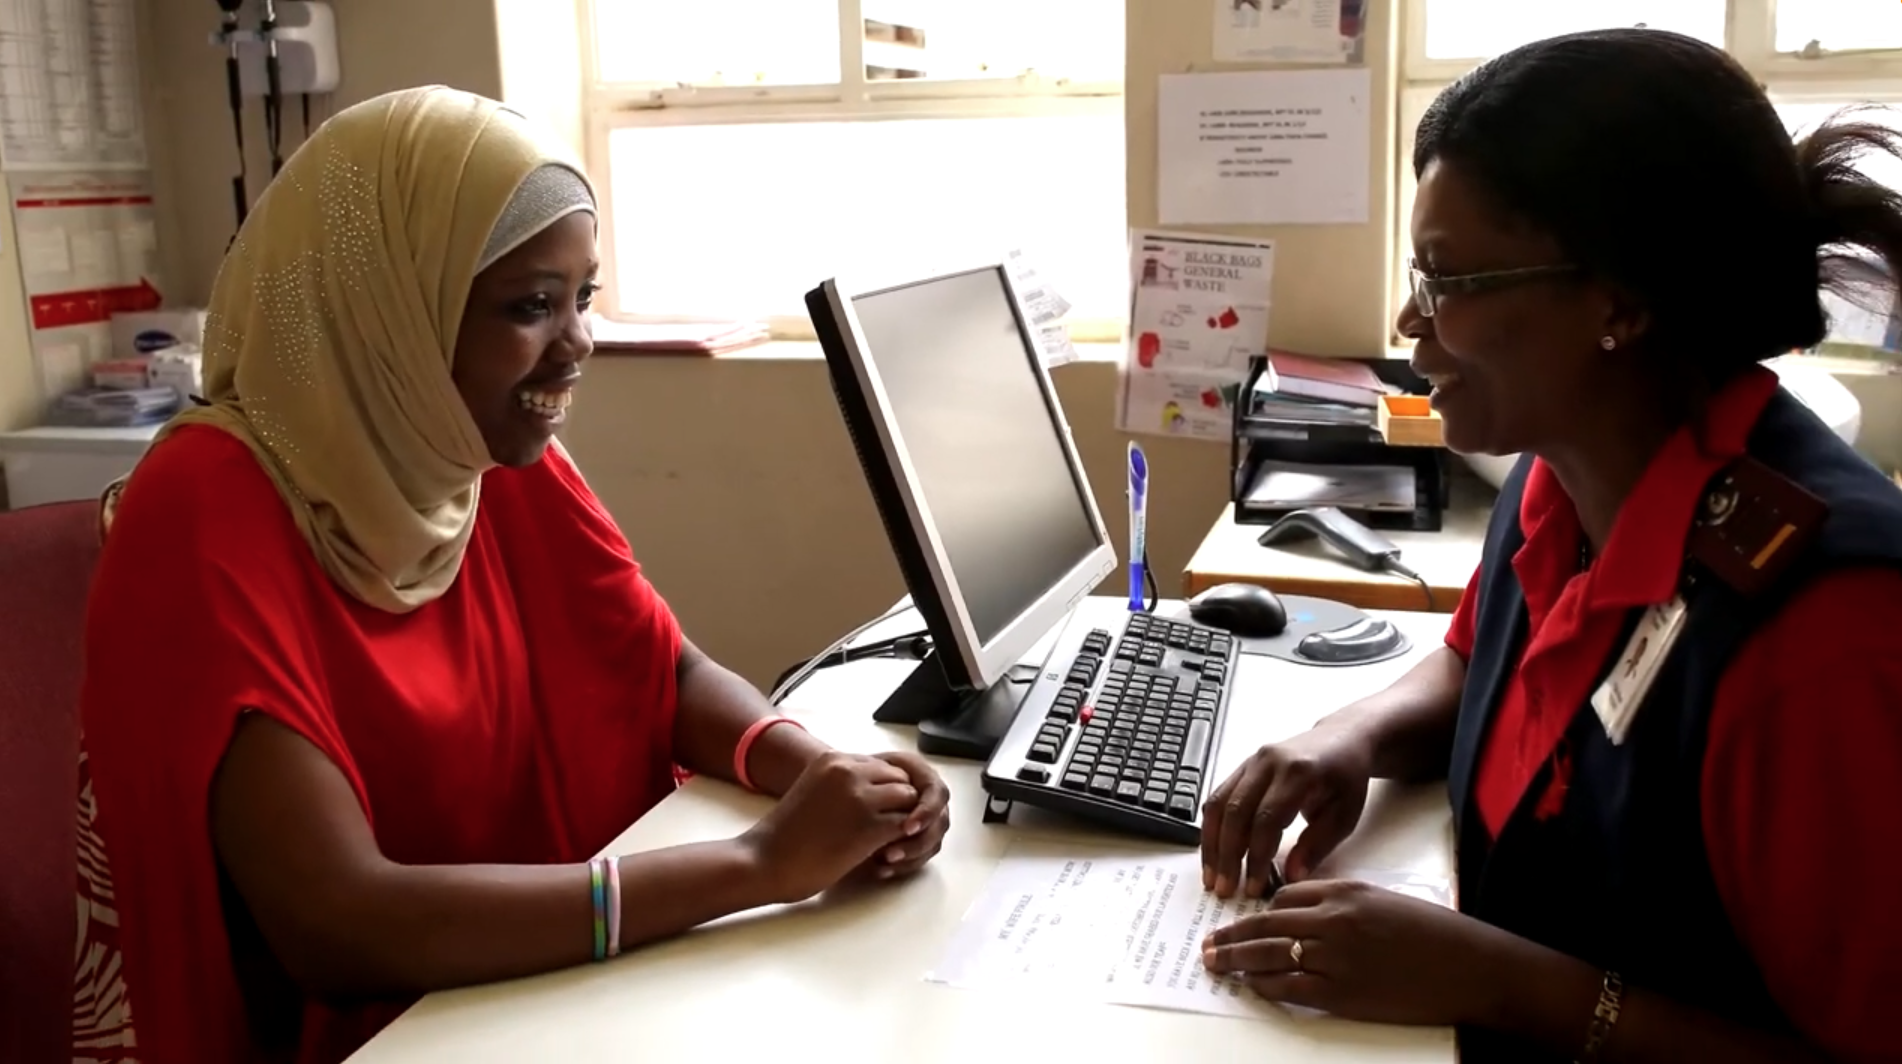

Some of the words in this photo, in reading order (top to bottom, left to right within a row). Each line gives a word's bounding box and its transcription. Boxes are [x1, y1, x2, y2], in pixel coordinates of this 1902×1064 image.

[1185, 251, 1227, 266] BLACK
[1230, 254, 1262, 268] BAGS
[1184, 265, 1243, 280] GENERAL
[1183, 278, 1226, 292] WASTE
